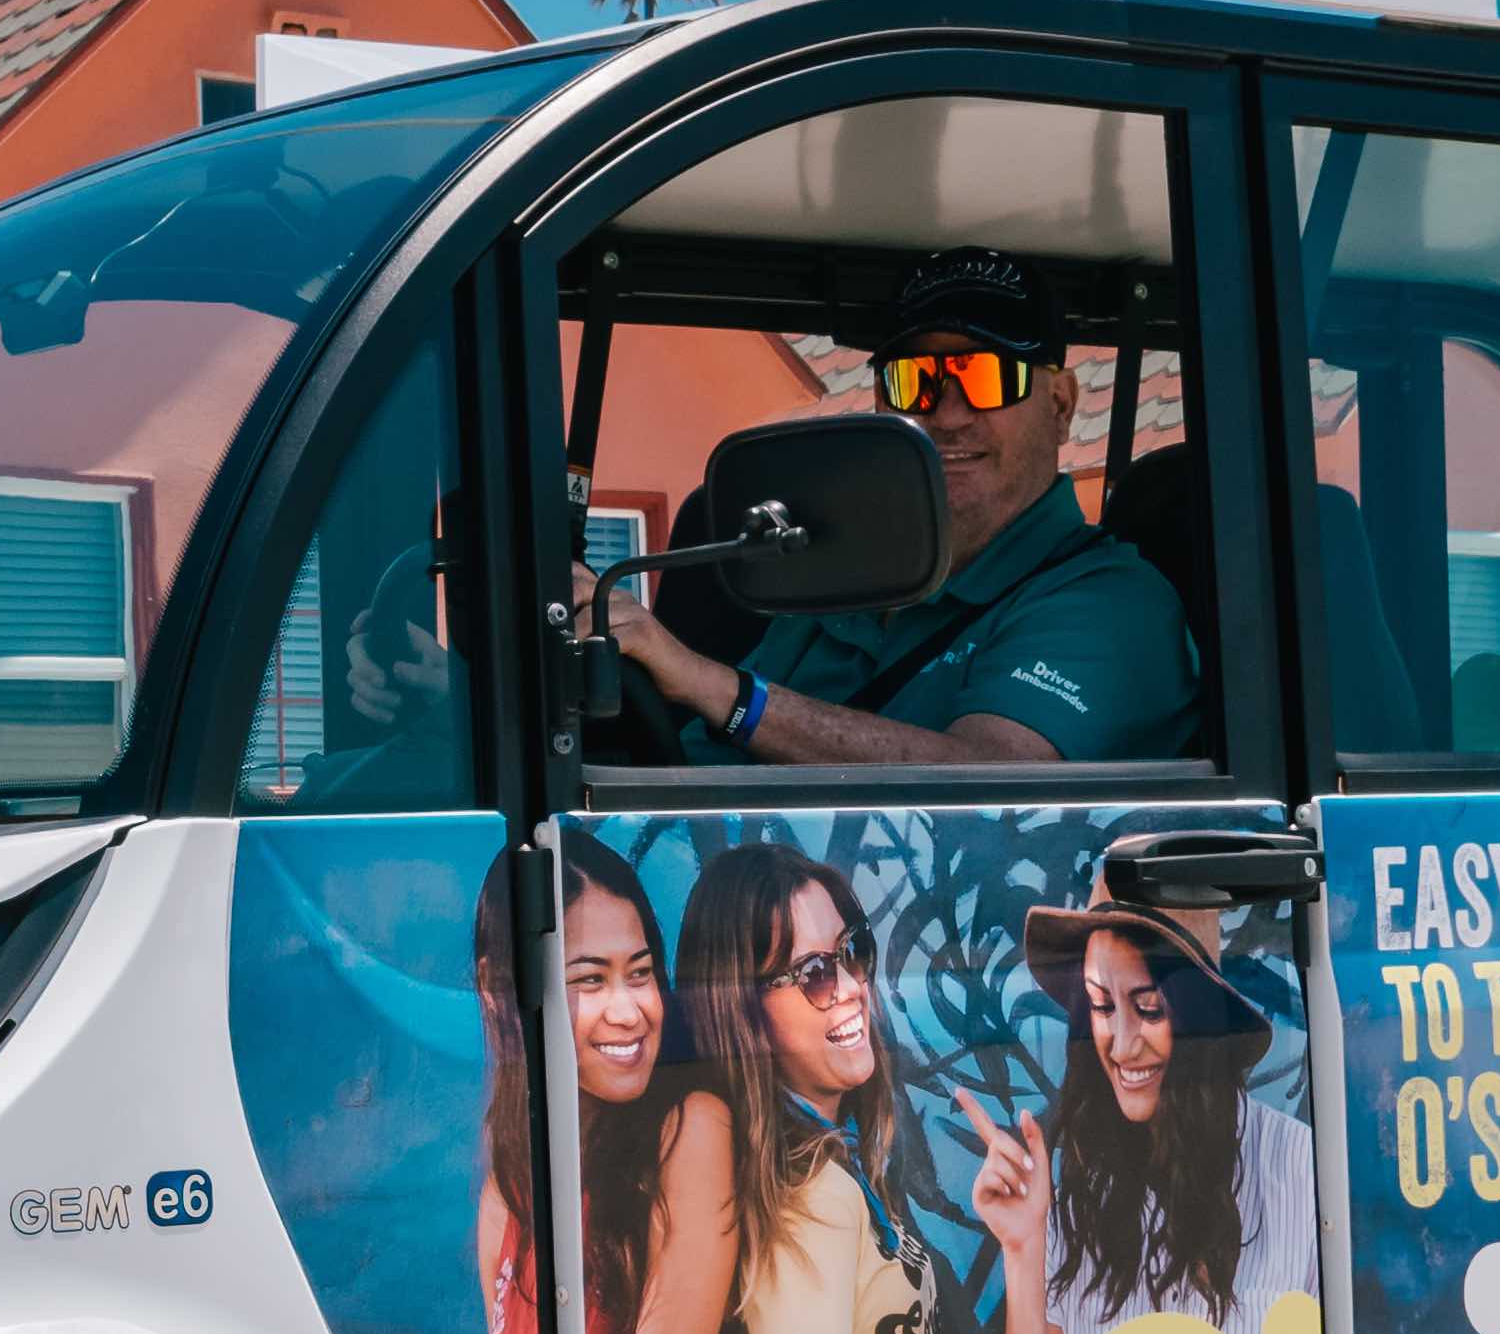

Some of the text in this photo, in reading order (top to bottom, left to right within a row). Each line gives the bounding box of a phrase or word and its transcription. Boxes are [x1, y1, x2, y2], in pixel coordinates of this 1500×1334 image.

[1011, 667, 1089, 714] Ambassador
[1033, 660, 1081, 694] Driver
[1382, 962, 1464, 1062] TO
[153, 1174, 210, 1220] e6
